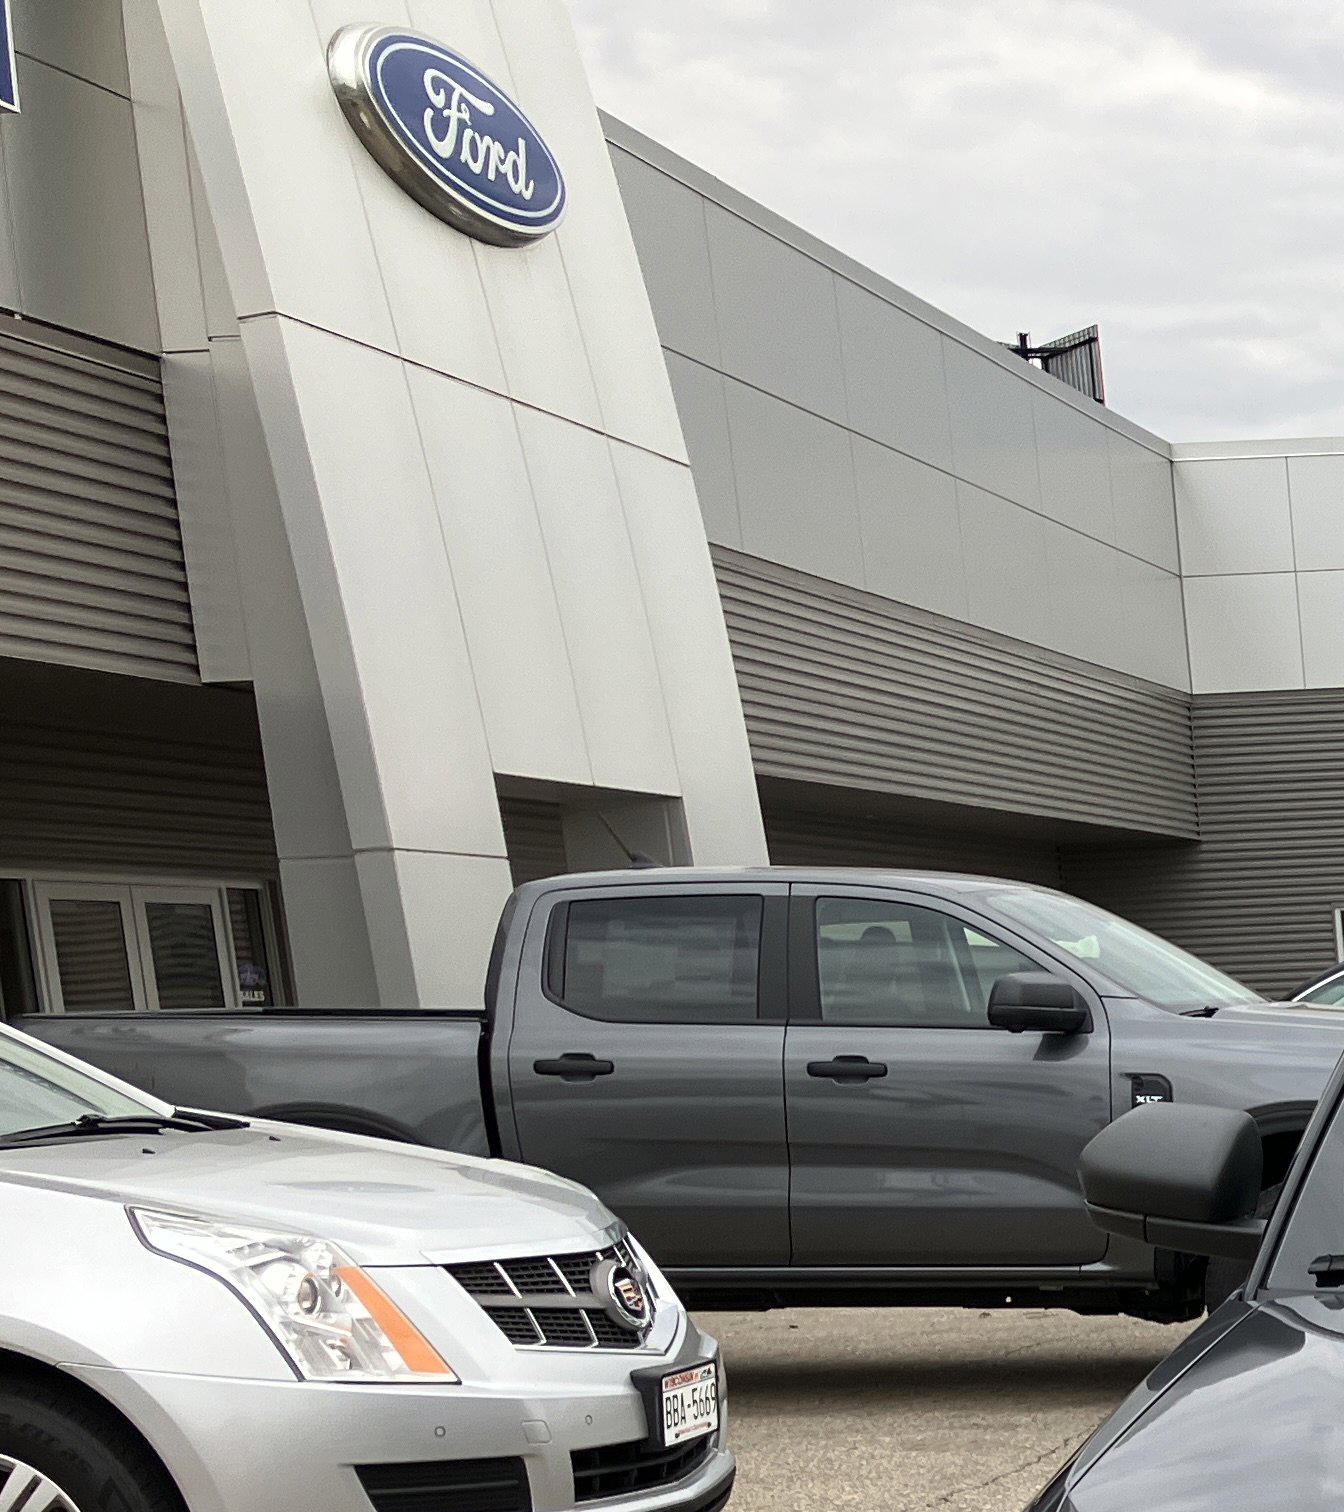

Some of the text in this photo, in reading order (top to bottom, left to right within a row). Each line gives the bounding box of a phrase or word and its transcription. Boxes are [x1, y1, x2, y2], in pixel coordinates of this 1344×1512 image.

[423, 68, 534, 200] Ford
[1136, 1095, 1163, 1103] XLT
[665, 1382, 717, 1430] BBA-5669
